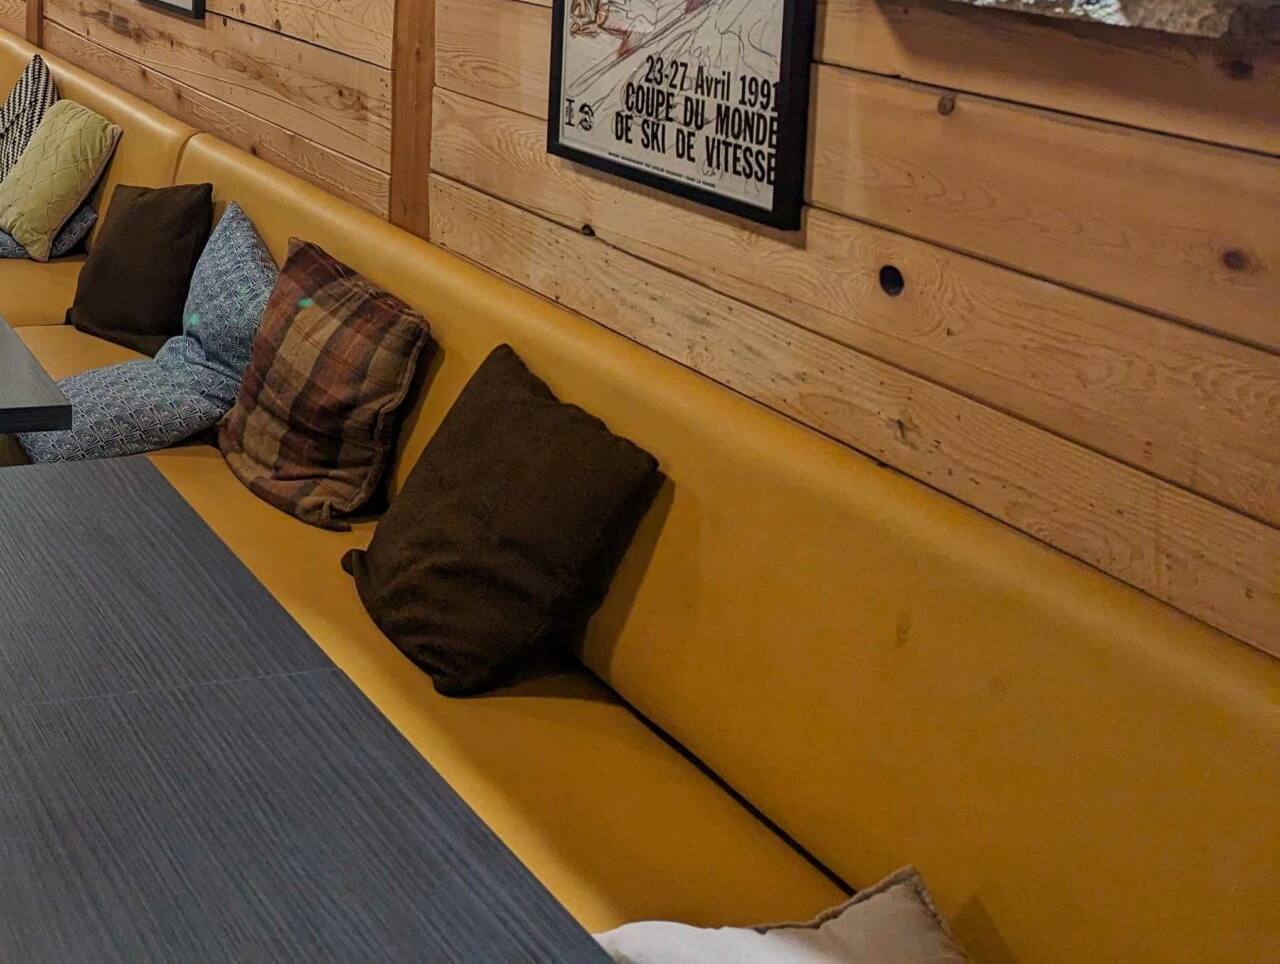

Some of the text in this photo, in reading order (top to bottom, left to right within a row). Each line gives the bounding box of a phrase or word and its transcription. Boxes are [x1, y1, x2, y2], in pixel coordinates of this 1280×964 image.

[625, 82, 674, 122] COUPE
[683, 96, 705, 131] DU
[715, 103, 778, 149] MONDE
[644, 55, 779, 112] 23-27 Avril 1991
[615, 111, 633, 144] DE
[641, 119, 666, 154] SKI
[676, 128, 696, 163] DE
[705, 136, 777, 186] VITESSE
